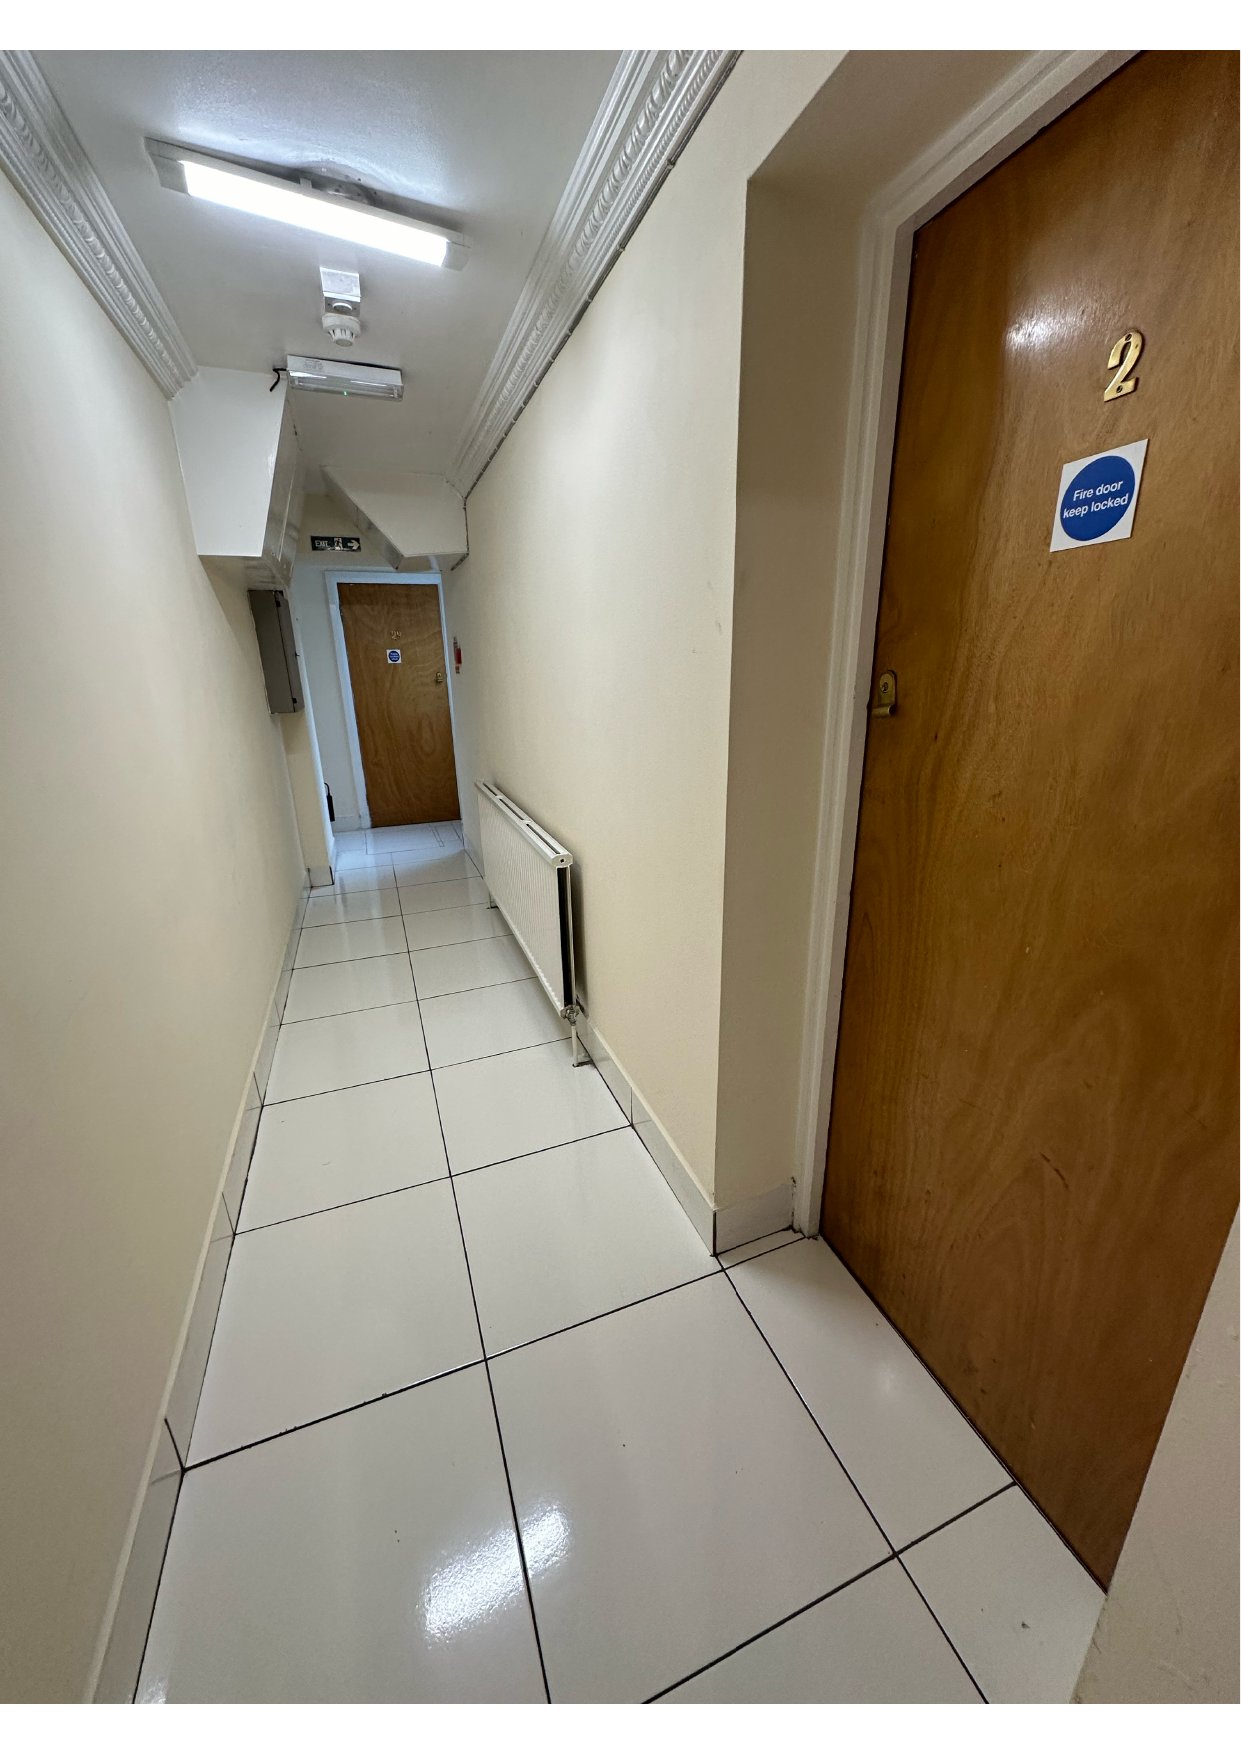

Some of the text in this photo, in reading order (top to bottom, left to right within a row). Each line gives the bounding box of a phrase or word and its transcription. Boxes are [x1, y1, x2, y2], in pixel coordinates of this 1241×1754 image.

[1103, 331, 1142, 402] 2
[1073, 481, 1123, 501] Fire door
[1063, 493, 1129, 518] keep locked
[314, 540, 329, 548] EXIT
